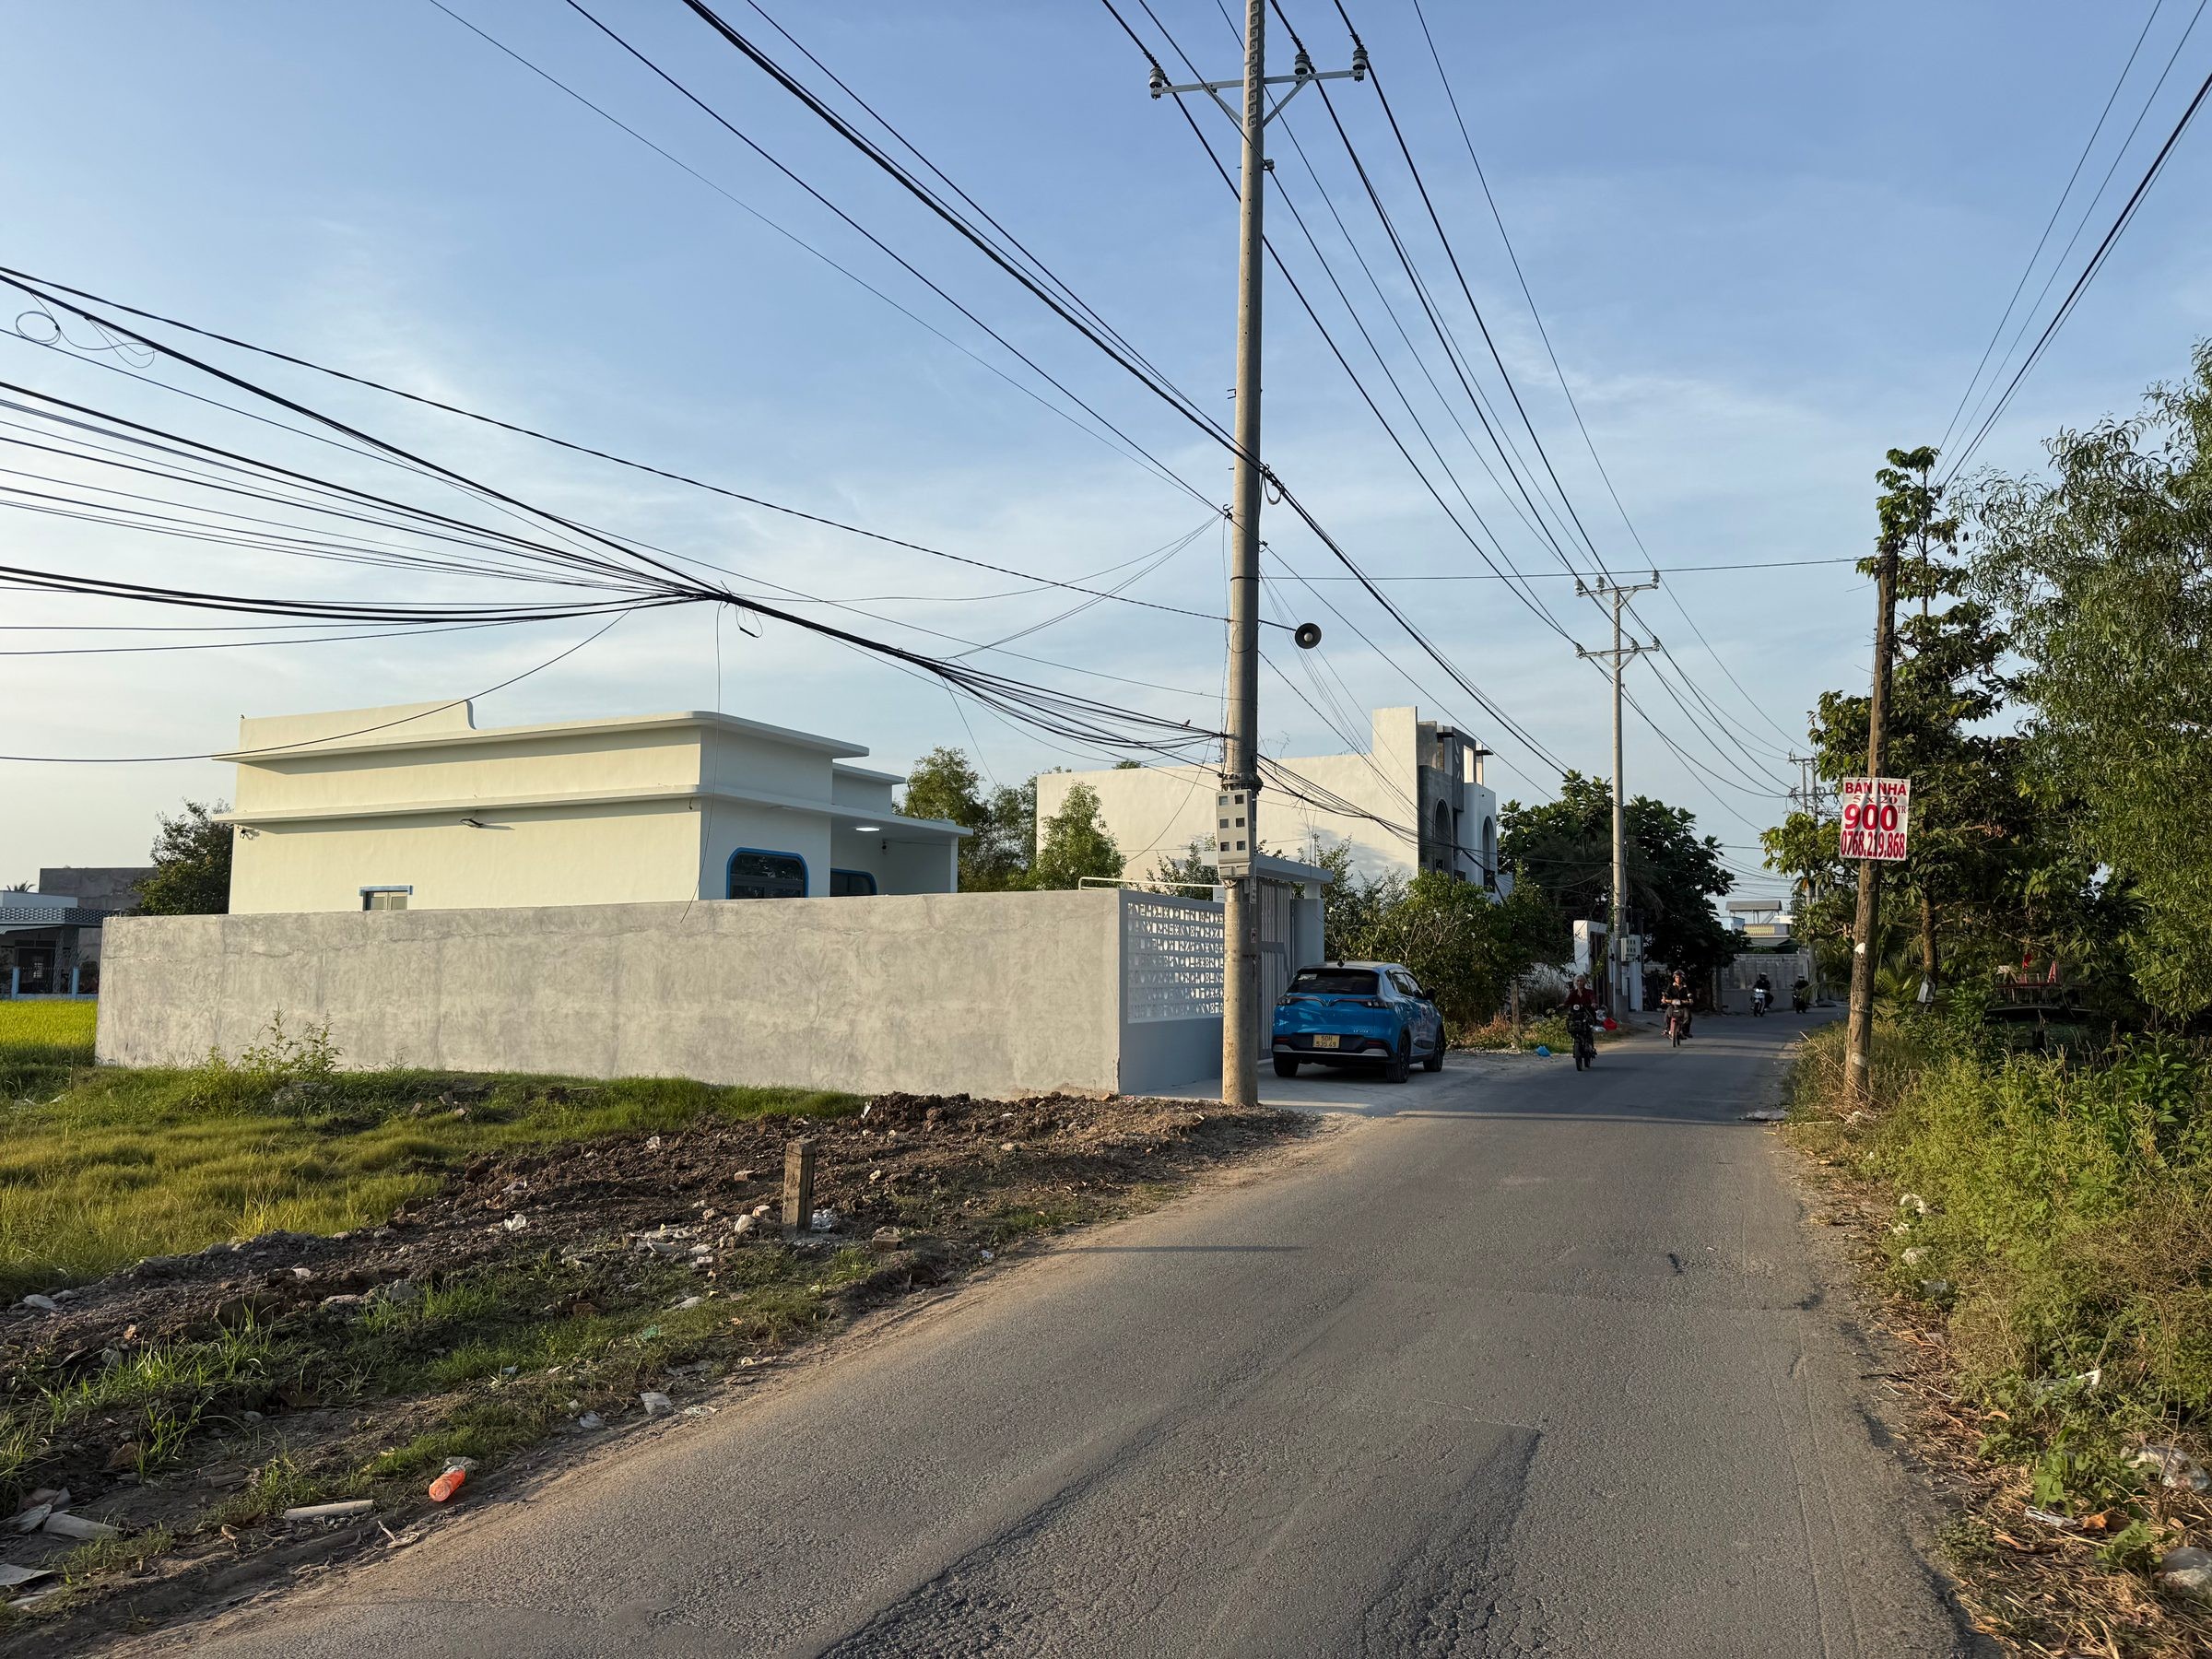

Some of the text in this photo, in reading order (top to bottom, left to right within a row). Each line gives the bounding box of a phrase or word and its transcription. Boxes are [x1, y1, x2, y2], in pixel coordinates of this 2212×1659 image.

[1845, 779, 1907, 795] BÁN NHÀ
[1844, 804, 1906, 831] 900 TR
[1841, 830, 1905, 858] 0768.219.868
